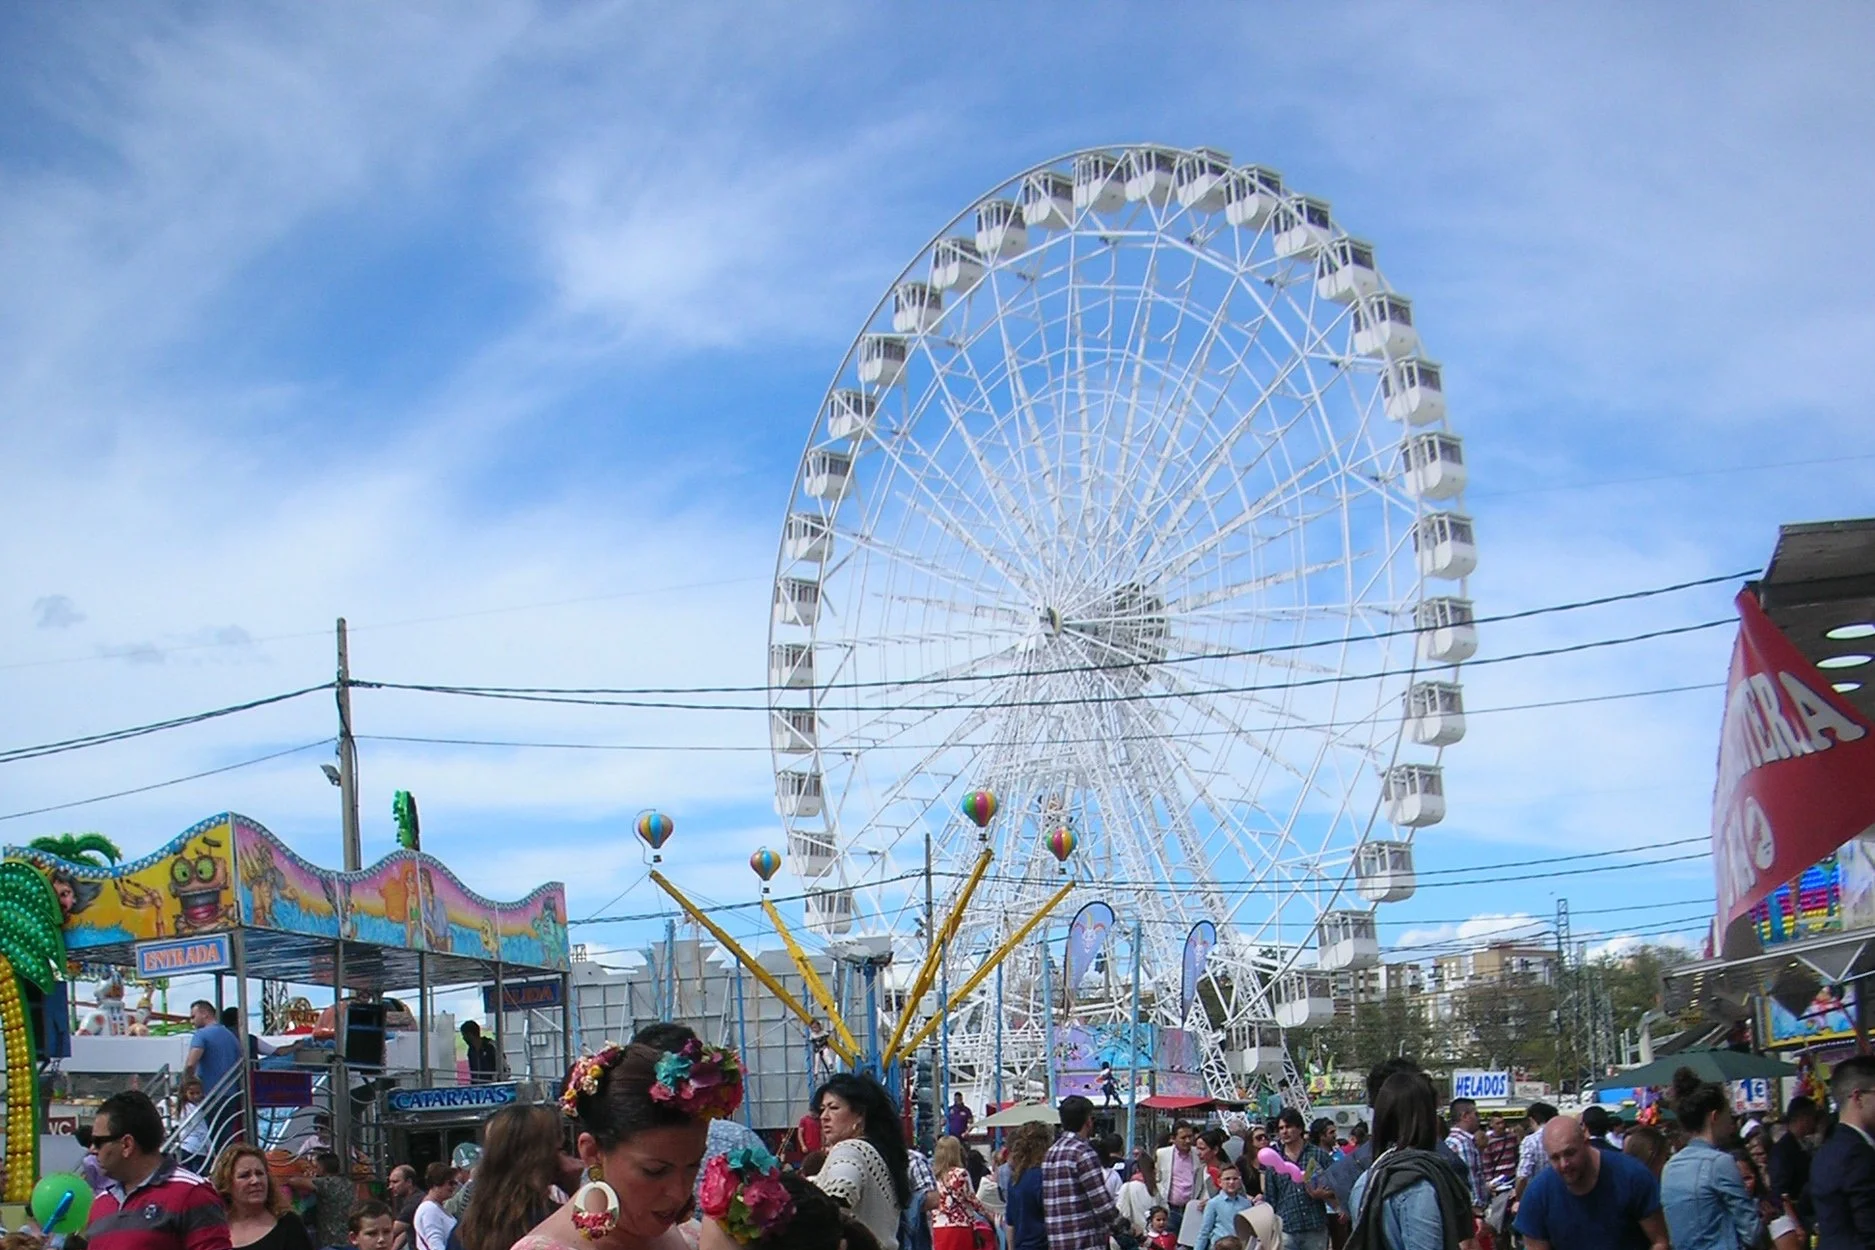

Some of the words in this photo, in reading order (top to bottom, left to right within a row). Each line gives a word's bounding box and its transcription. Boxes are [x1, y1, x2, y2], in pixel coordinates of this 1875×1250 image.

[143, 943, 220, 971] ENTRADA
[395, 1086, 508, 1109] CATARATAS
[1456, 1075, 1506, 1097] HELADOS
